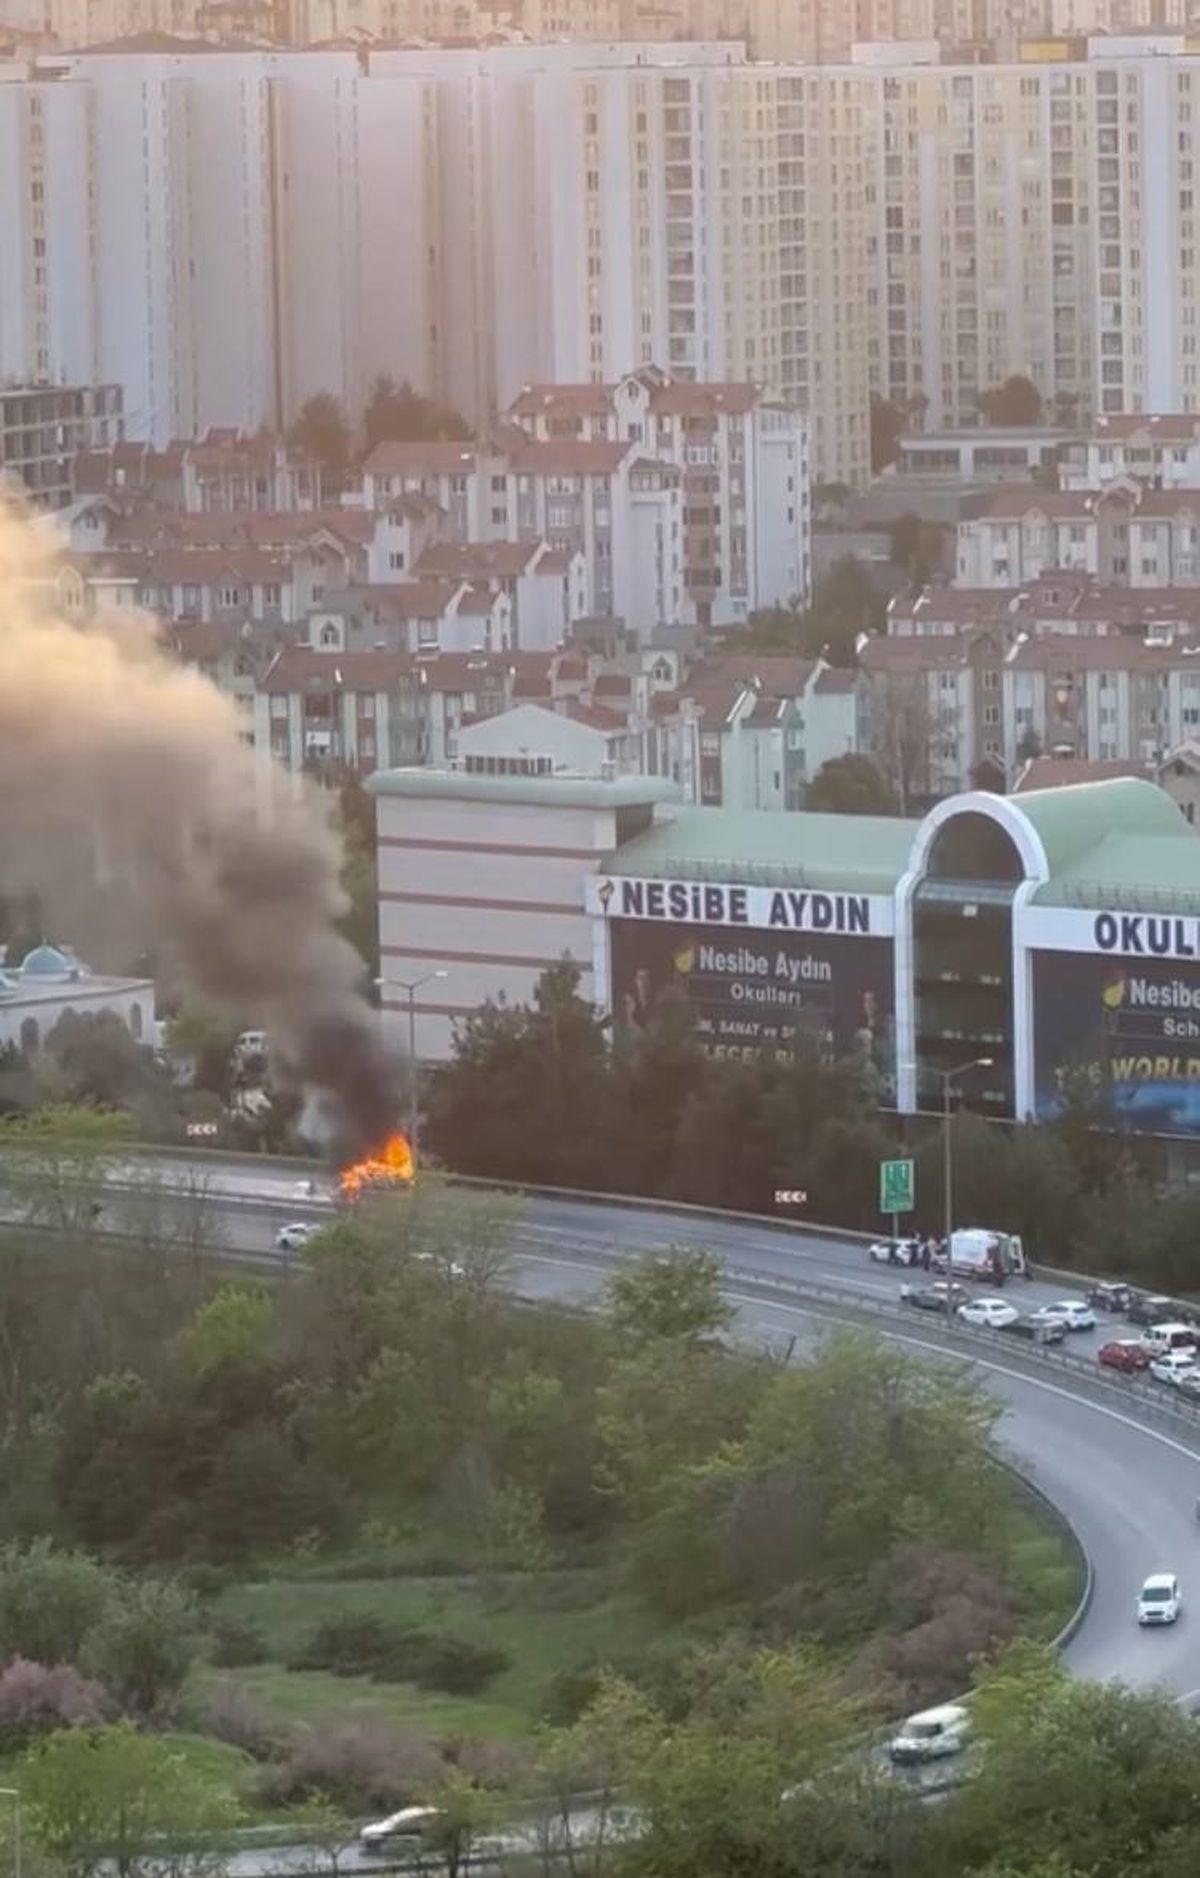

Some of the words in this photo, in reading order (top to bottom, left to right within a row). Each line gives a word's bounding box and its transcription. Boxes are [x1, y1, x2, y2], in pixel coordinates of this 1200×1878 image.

[769, 891, 870, 933] AYDIN
[1094, 914, 1200, 955] OKUL
[700, 945, 769, 975] Nesibe
[775, 952, 832, 982] Aydın
